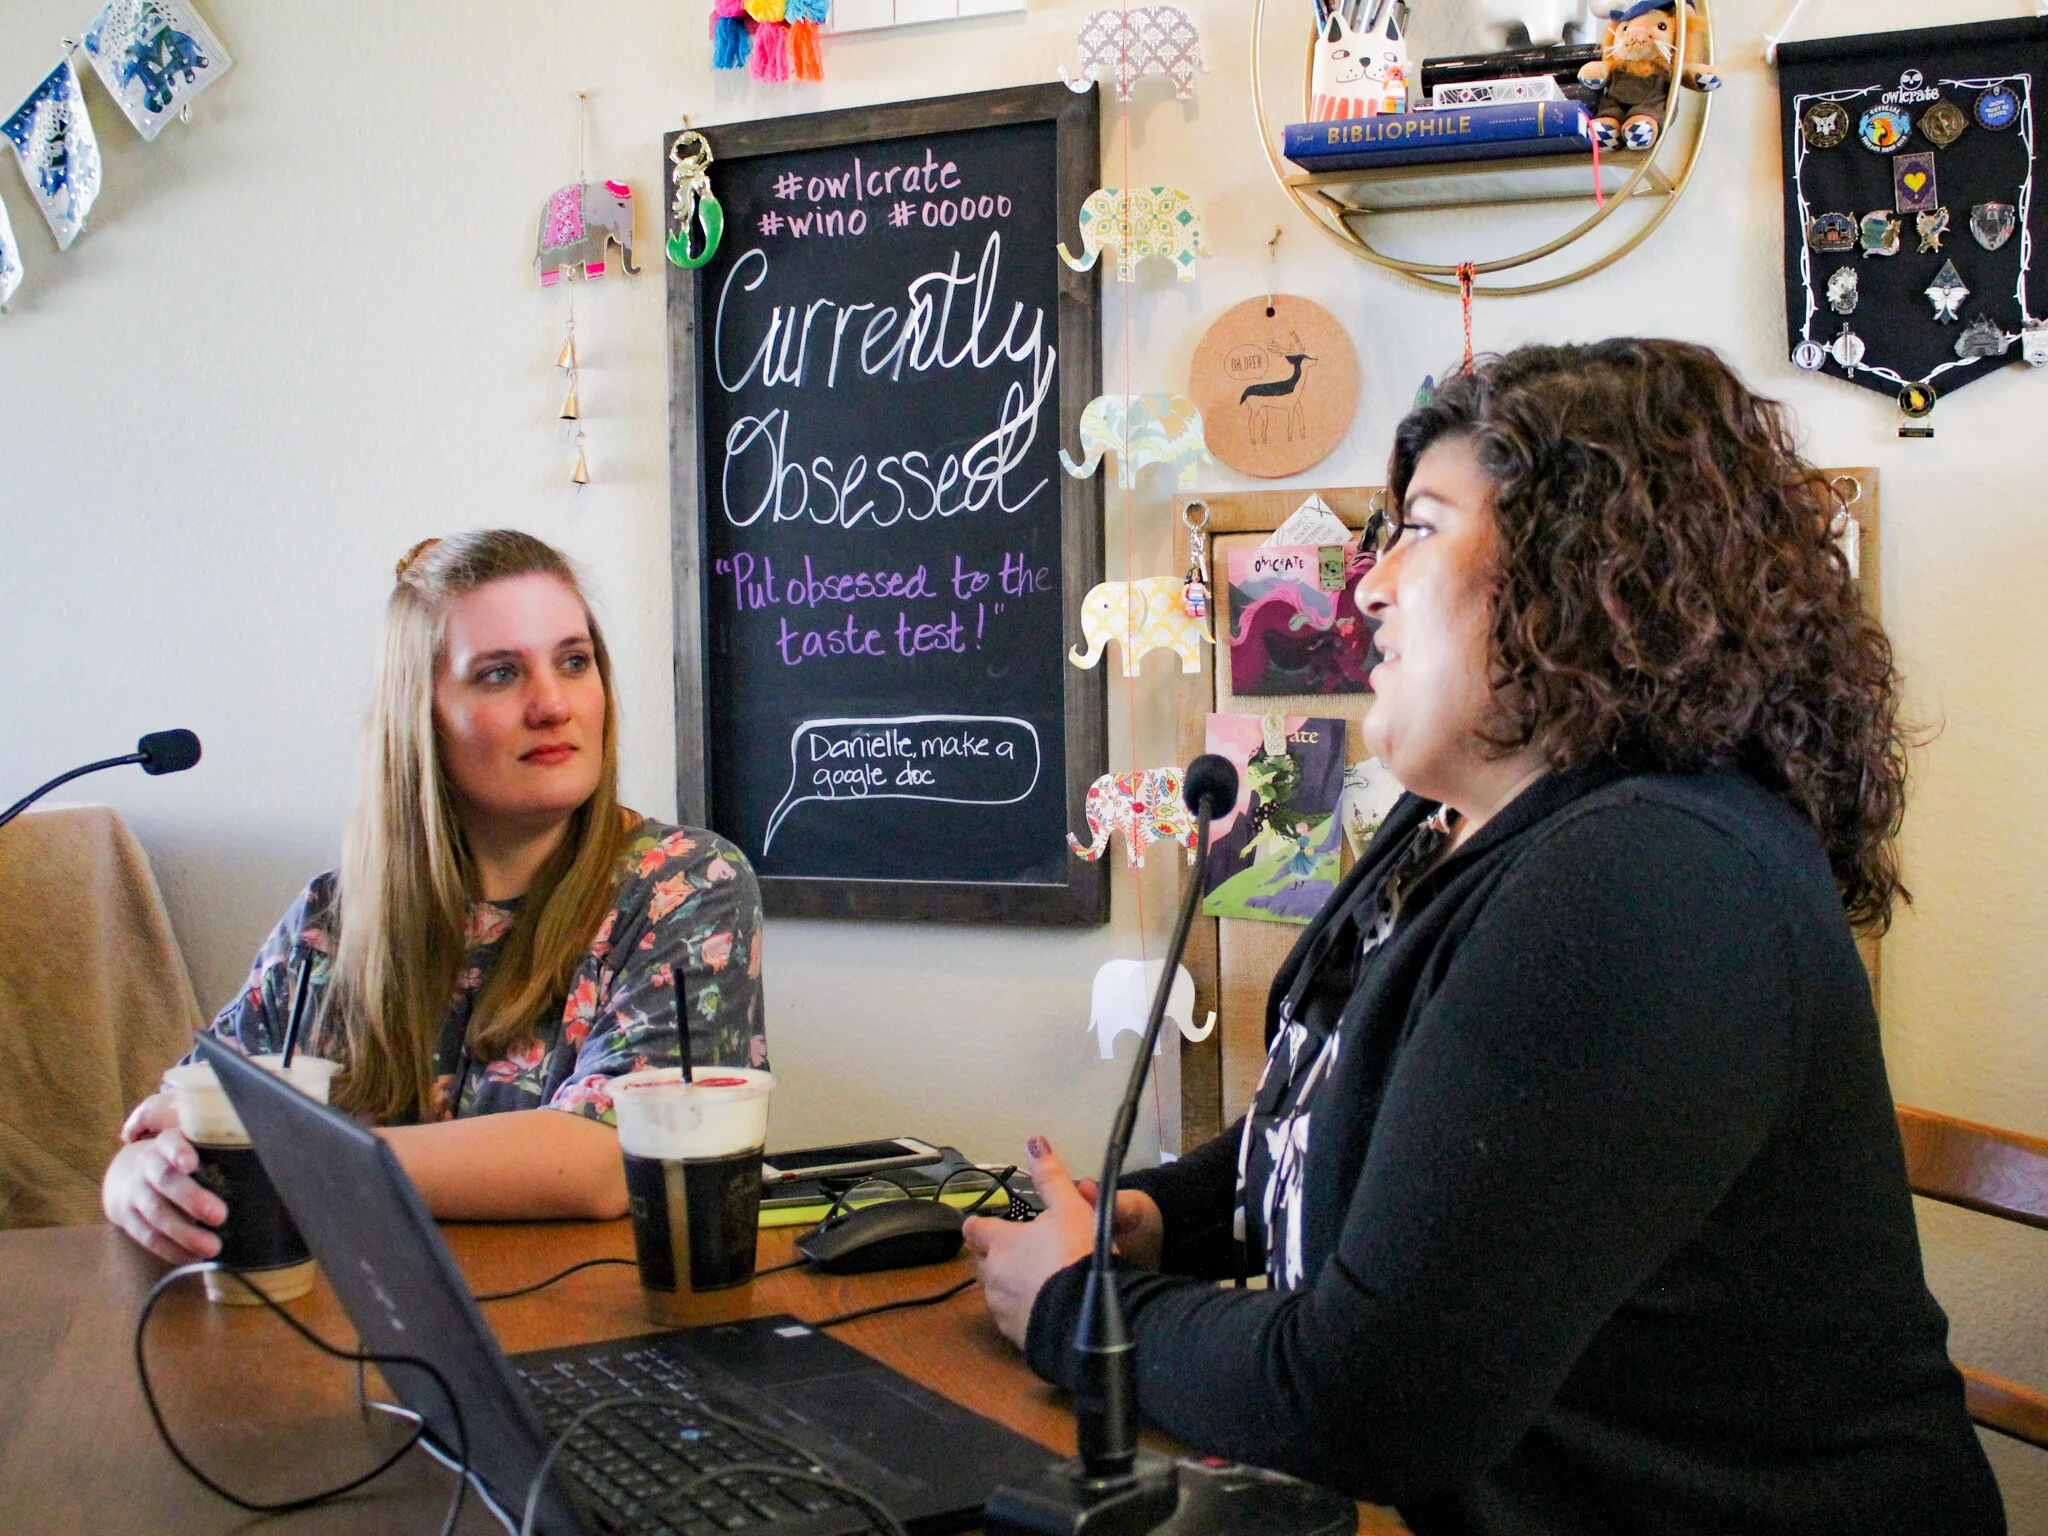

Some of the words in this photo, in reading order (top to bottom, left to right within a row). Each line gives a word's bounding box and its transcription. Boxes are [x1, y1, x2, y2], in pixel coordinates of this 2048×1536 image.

[1881, 85, 1940, 104] owlcrate
[1327, 115, 1472, 145] BIBLIOPHILE
[772, 148, 961, 201] #owlcrate
[757, 210, 867, 239] #wino
[715, 230, 1057, 478] Currently
[722, 381, 1049, 529] Obsessed
[786, 554, 937, 609] obsessed
[952, 554, 990, 600] to
[999, 552, 1052, 597] the
[775, 613, 886, 665] taste
[921, 731, 990, 758] make
[995, 738, 1014, 759] a
[813, 763, 888, 799] google
[895, 762, 936, 785] doc
